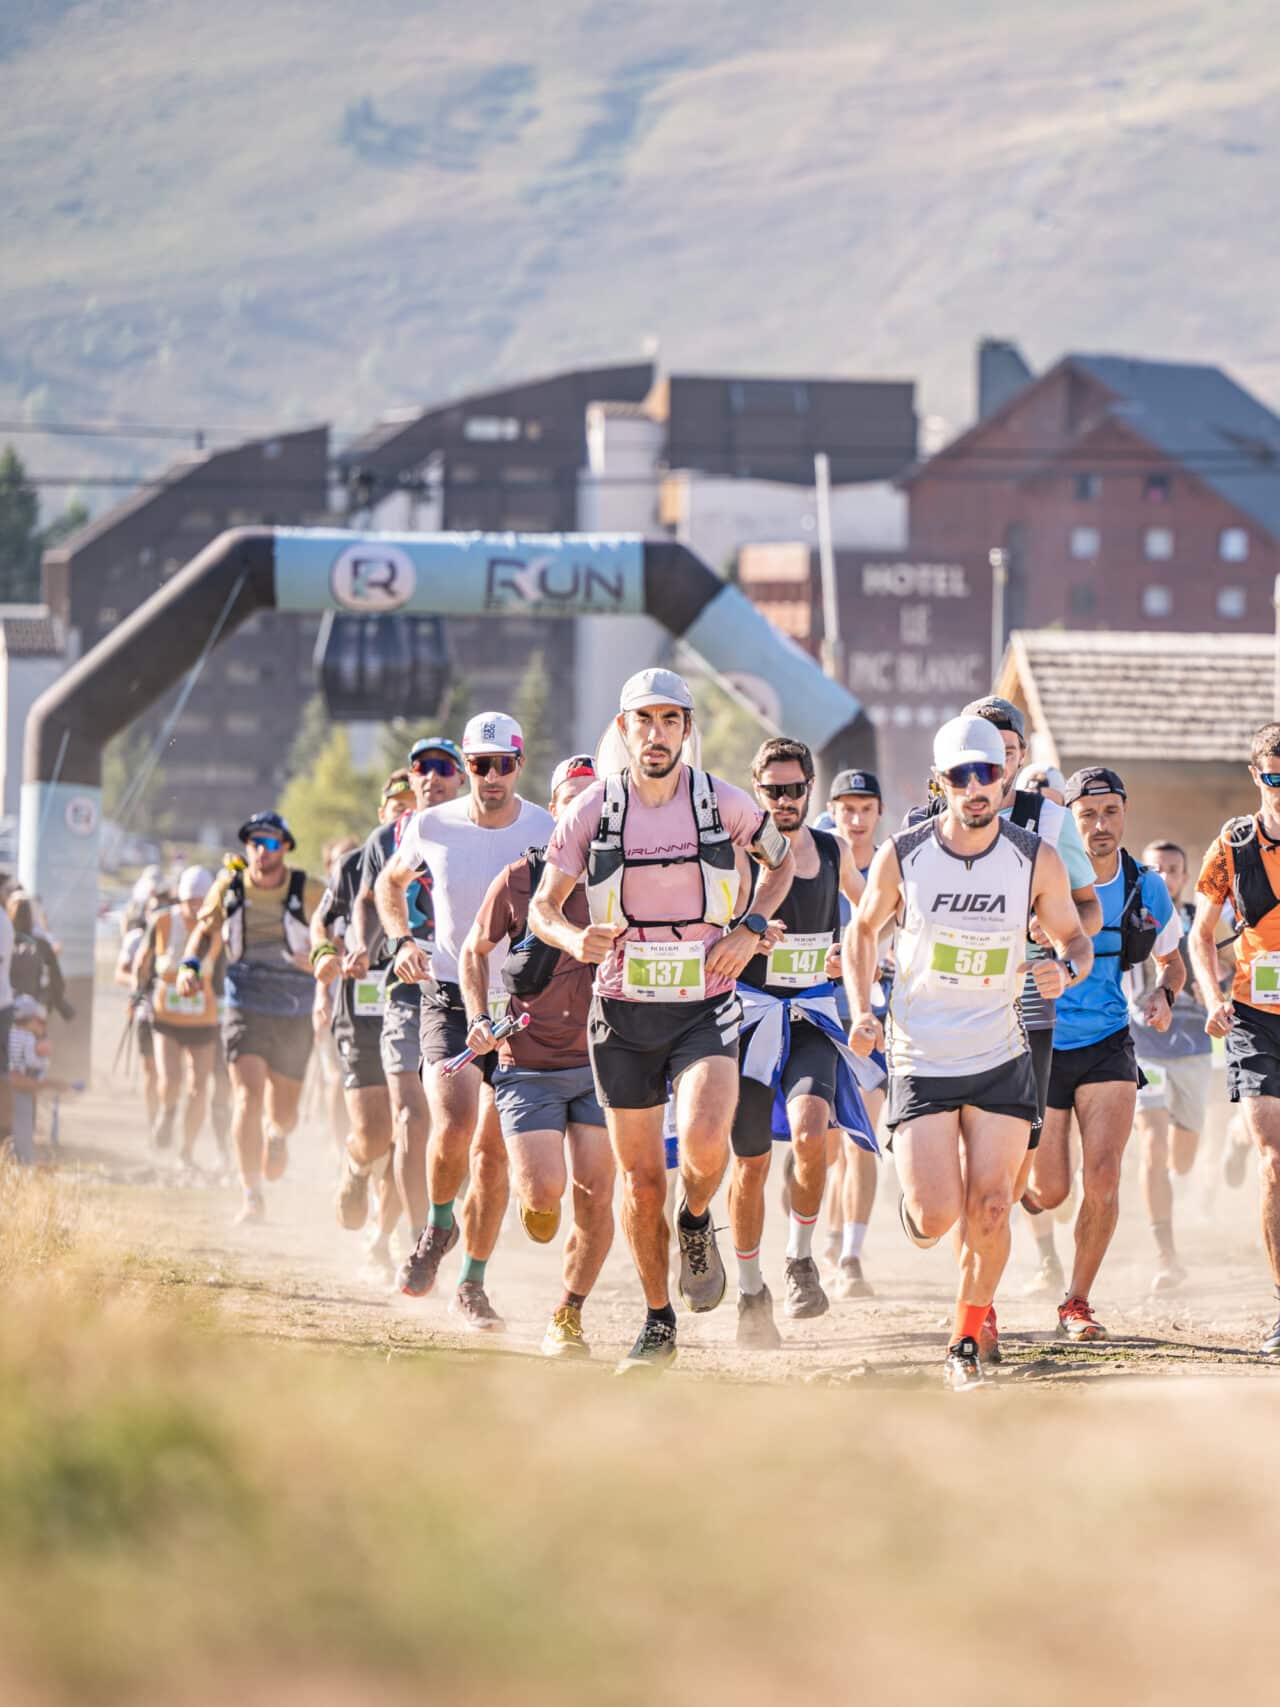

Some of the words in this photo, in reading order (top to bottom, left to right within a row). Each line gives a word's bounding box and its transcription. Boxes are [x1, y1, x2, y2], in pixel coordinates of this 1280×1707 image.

[486, 556, 625, 602] RUN
[863, 563, 970, 597] HOTEL
[901, 604, 931, 645] LE
[850, 652, 895, 693] PIC
[899, 652, 983, 694] BLANC
[931, 893, 1006, 914] FUGA
[645, 961, 684, 985] 137
[789, 950, 819, 973] 147
[954, 949, 988, 975] 58
